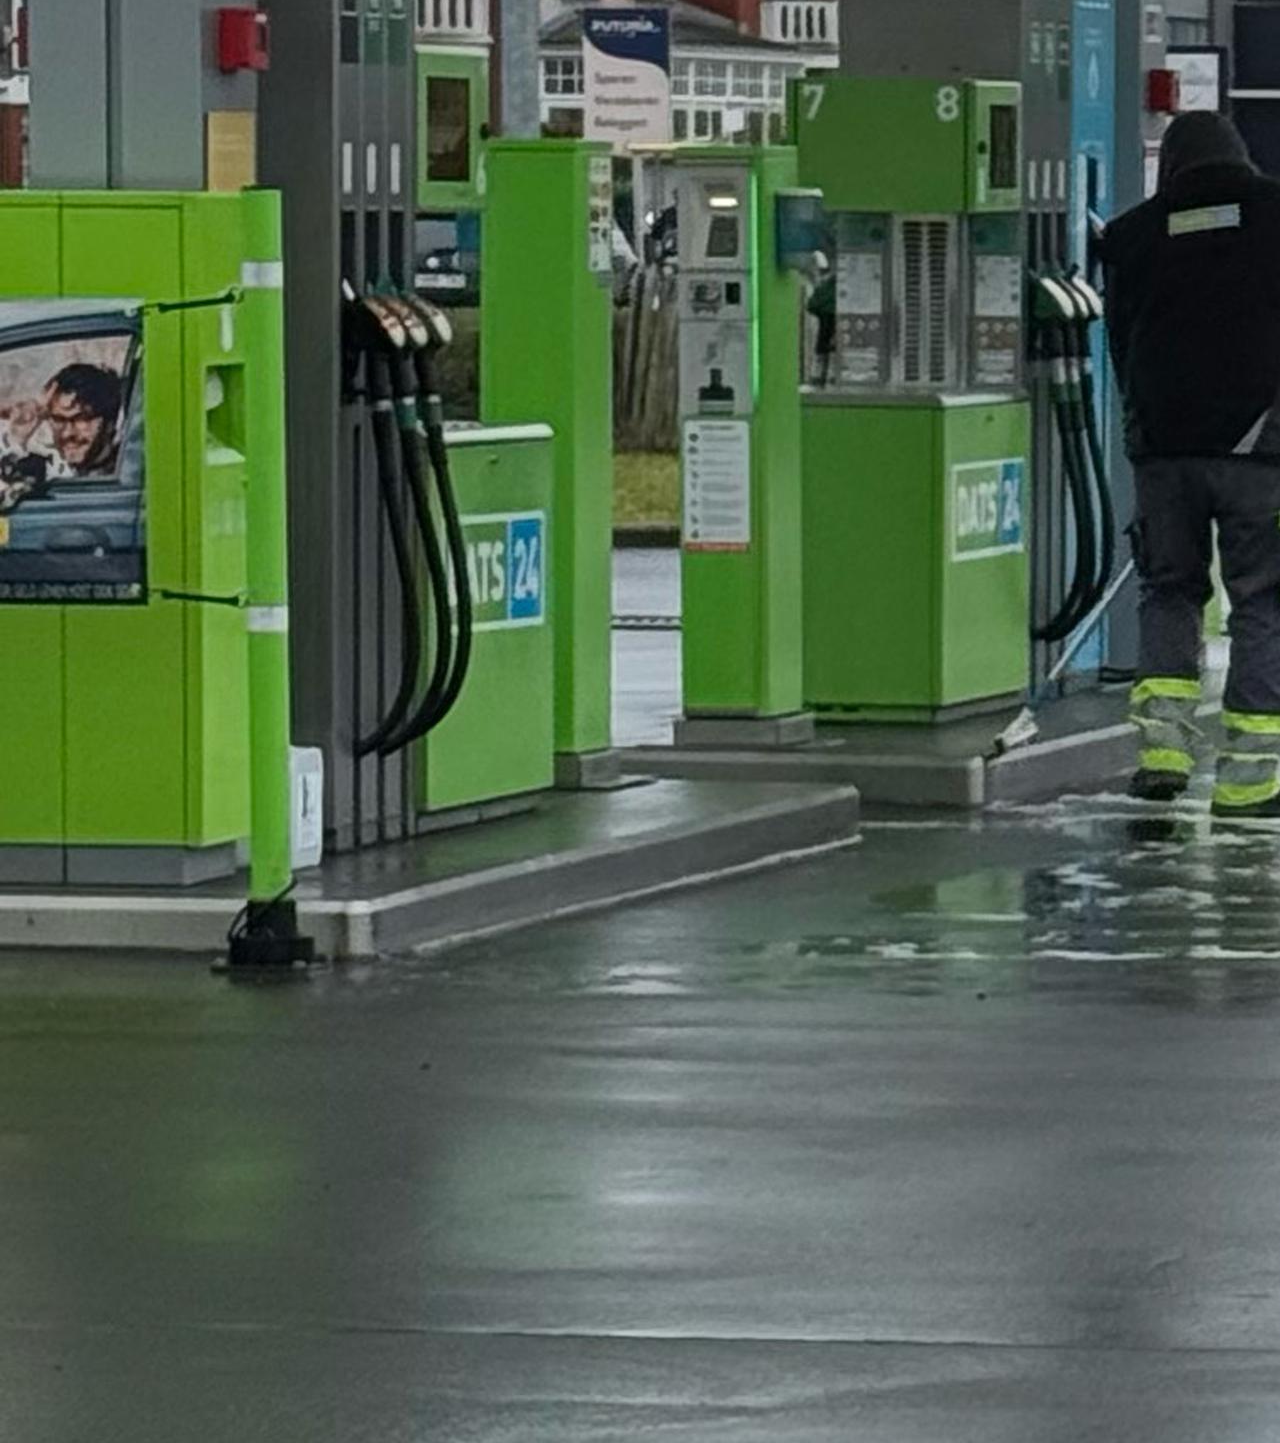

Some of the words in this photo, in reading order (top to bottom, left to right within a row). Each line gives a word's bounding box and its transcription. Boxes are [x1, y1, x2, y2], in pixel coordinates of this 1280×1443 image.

[804, 83, 824, 120] 7
[937, 85, 959, 121] 8
[957, 480, 997, 536] DATS
[1002, 477, 1021, 530] 24
[514, 536, 539, 599] 24
